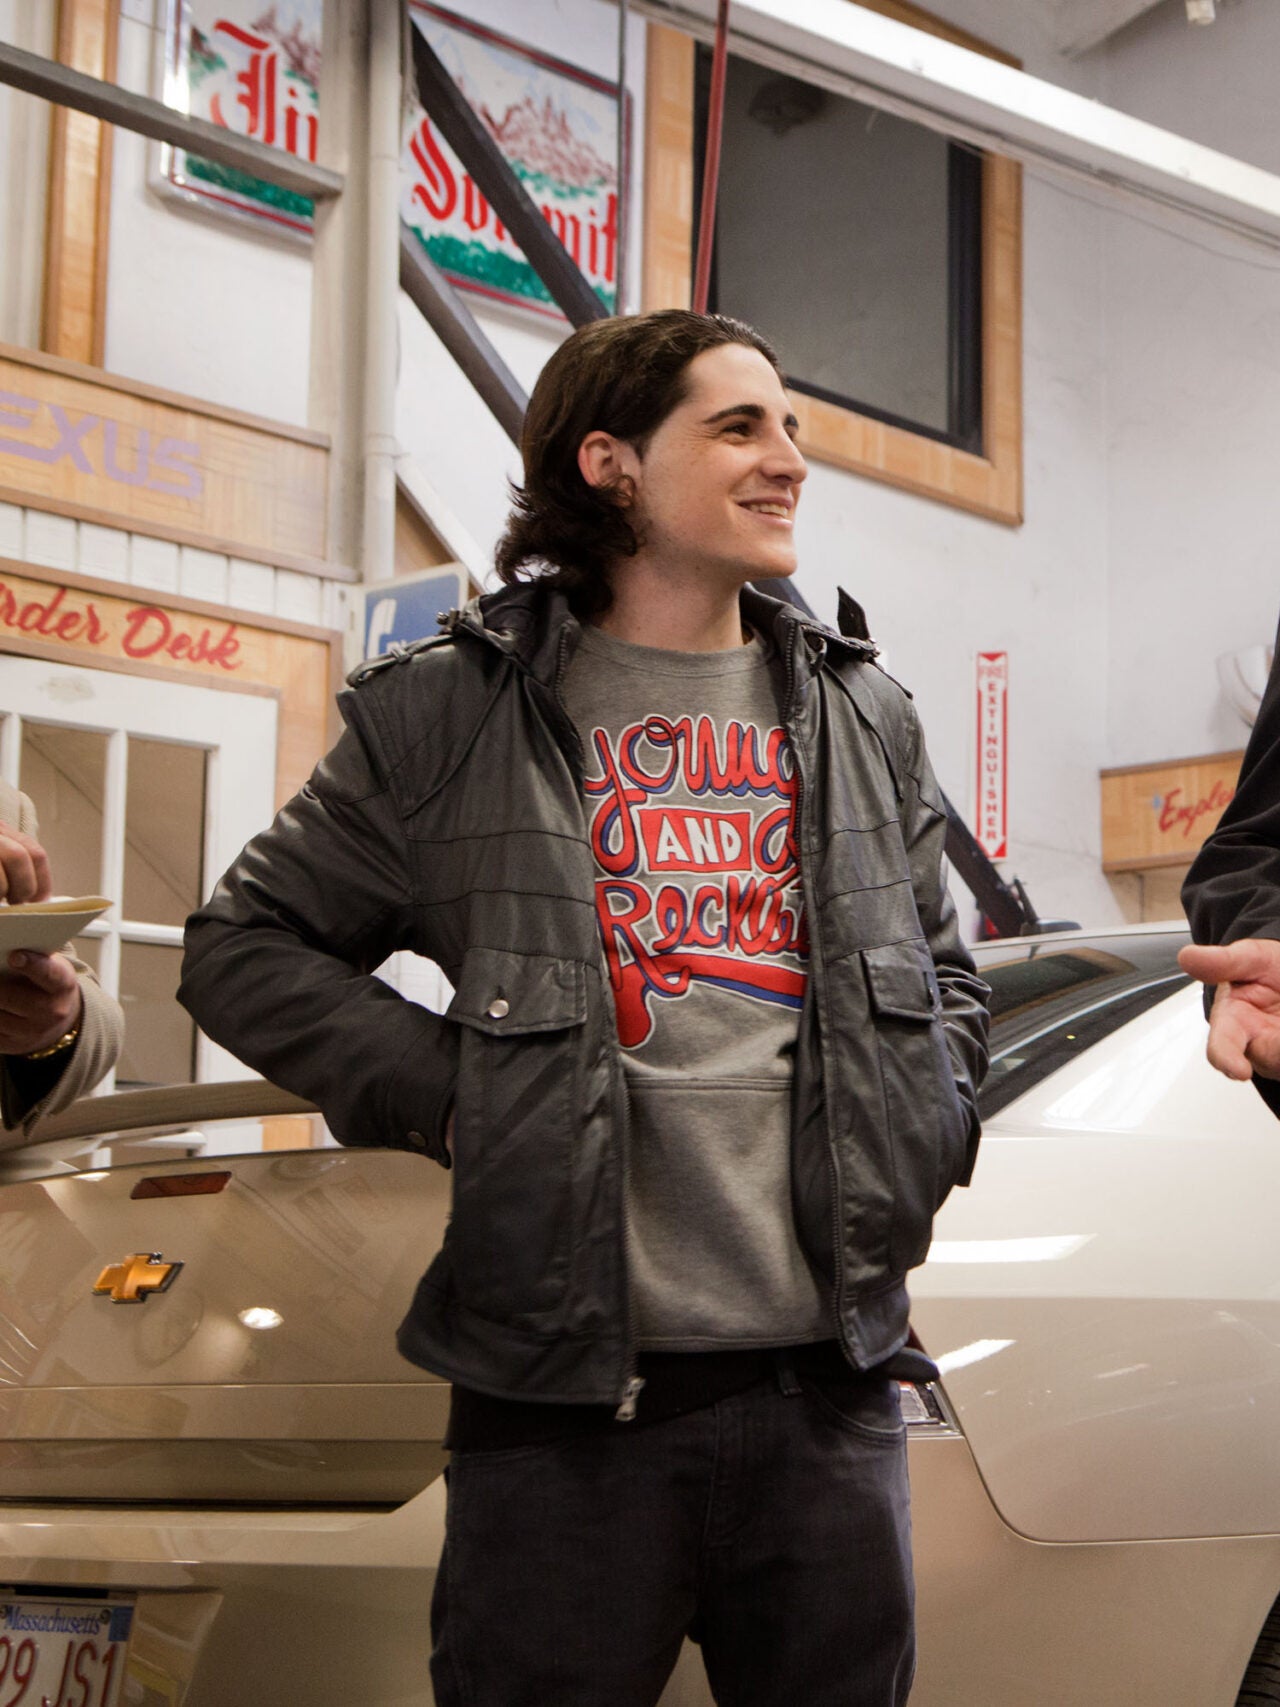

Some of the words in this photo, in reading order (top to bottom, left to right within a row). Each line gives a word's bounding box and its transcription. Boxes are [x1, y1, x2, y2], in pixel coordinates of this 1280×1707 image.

[409, 117, 618, 283] Sumit
[122, 606, 243, 671] Desk
[985, 682, 998, 840] EXTINGUISHER
[655, 814, 743, 865] AND
[4, 1605, 100, 1635] Massachusetts
[42, 1640, 118, 1707] JS1
